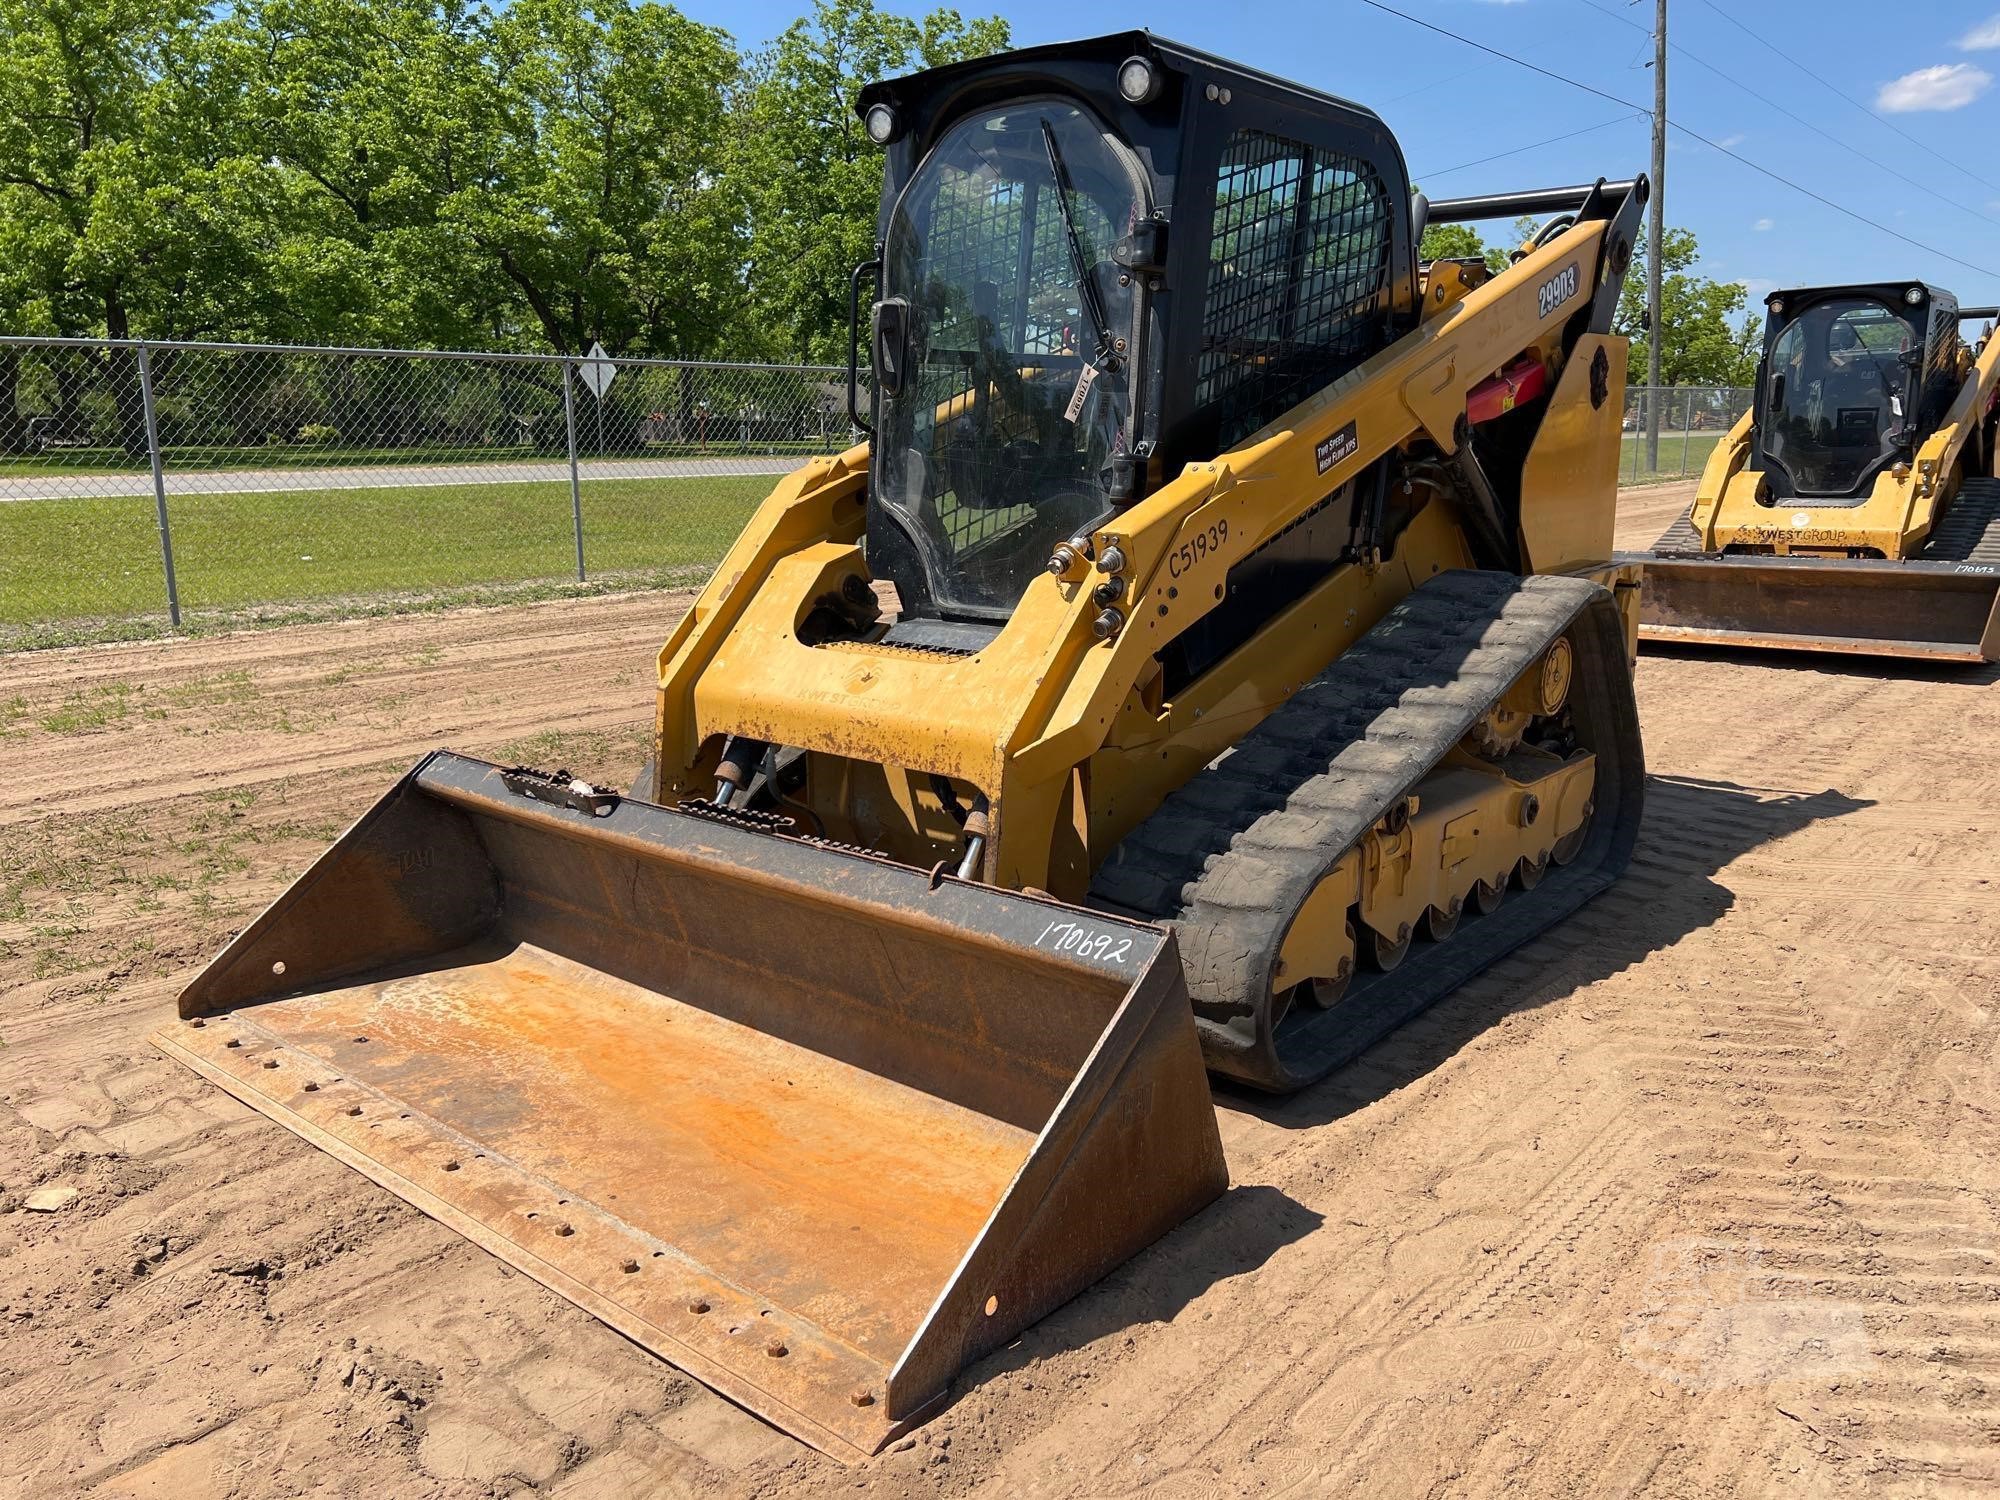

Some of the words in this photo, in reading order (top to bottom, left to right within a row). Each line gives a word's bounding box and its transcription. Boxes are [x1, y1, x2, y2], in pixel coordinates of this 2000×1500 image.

[1539, 265, 1576, 319] 299D3
[1345, 437, 1356, 454] XPS
[1169, 518, 1228, 579] C51939
[1034, 921, 1133, 963] 170692
